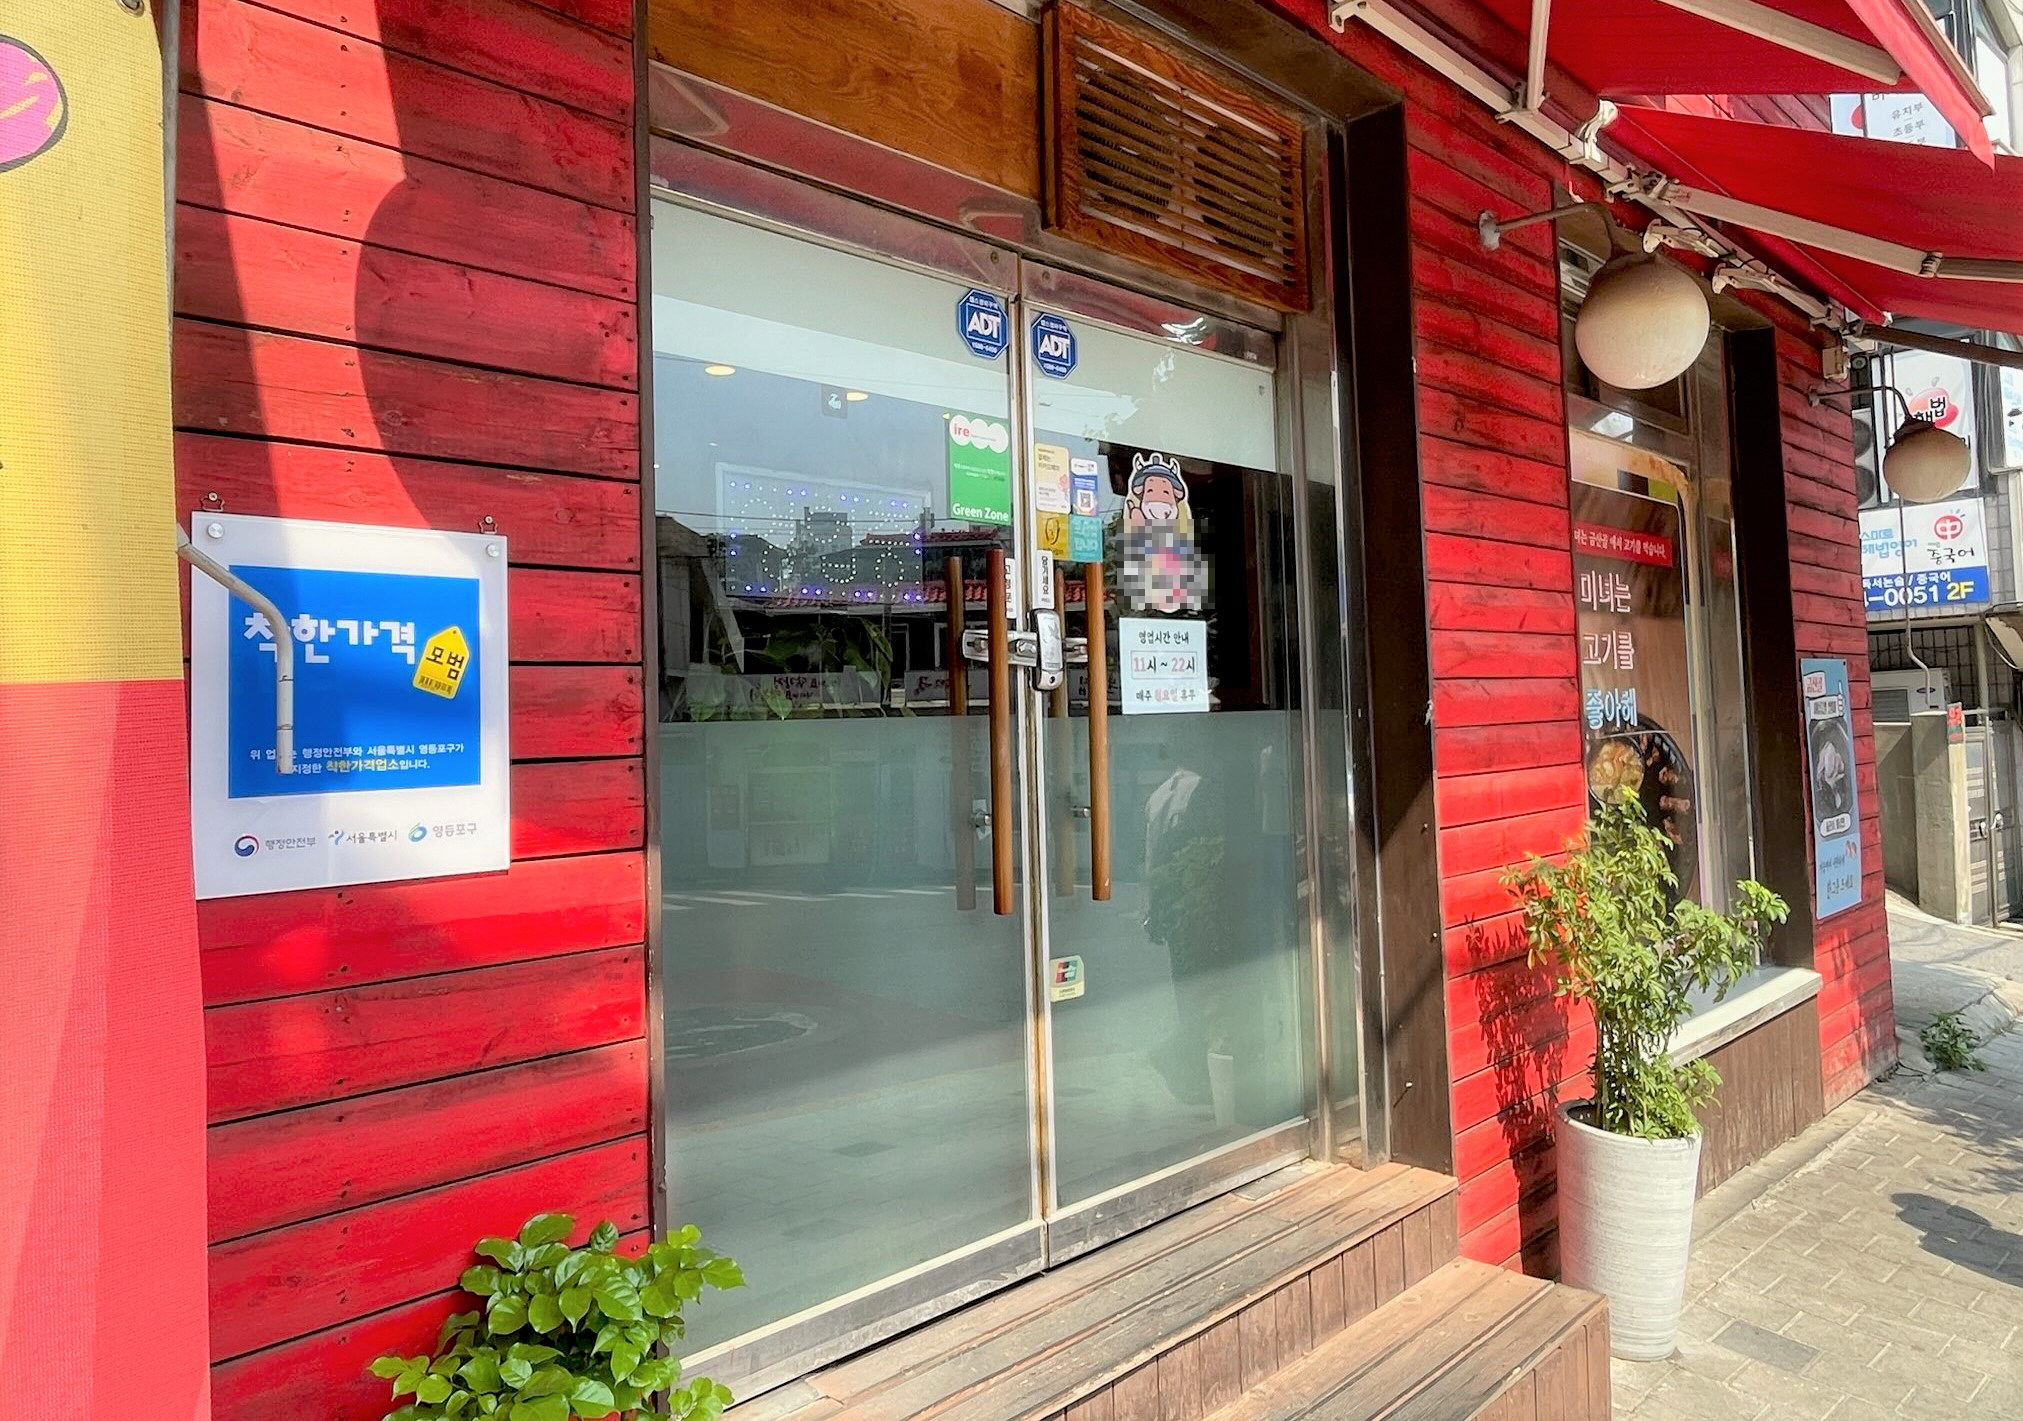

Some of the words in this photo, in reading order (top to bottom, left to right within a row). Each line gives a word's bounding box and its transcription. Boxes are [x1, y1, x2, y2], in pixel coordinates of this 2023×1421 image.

[967, 311, 1001, 339] ADT
[1040, 334, 1070, 360] ADT
[952, 502, 984, 518] Green
[984, 506, 1010, 522] Zone
[1927, 546, 1975, 566] 중국어
[1916, 570, 1952, 586] 중국어
[1580, 570, 1632, 613] 미녀는
[1946, 581, 1975, 601] 2F
[1138, 630, 1170, 645] 영업시간
[1173, 631, 1190, 645] 안내
[1583, 629, 1635, 670] 고기를
[426, 646, 465, 680] 모범
[1133, 655, 1157, 674] 11시
[1171, 656, 1196, 673] 22시
[1135, 689, 1152, 702] 매주
[1585, 687, 1638, 730] 좋아해
[249, 749, 262, 761] 위
[302, 746, 363, 760] 행정안전부와
[366, 743, 416, 757] 서울특별시
[418, 743, 465, 755] 영등포구가
[326, 758, 431, 774] 착한가격업소입니다.
[345, 829, 398, 845] 서울특별시
[432, 822, 478, 839] 영등포구
[264, 837, 317, 852] 행정안전부
